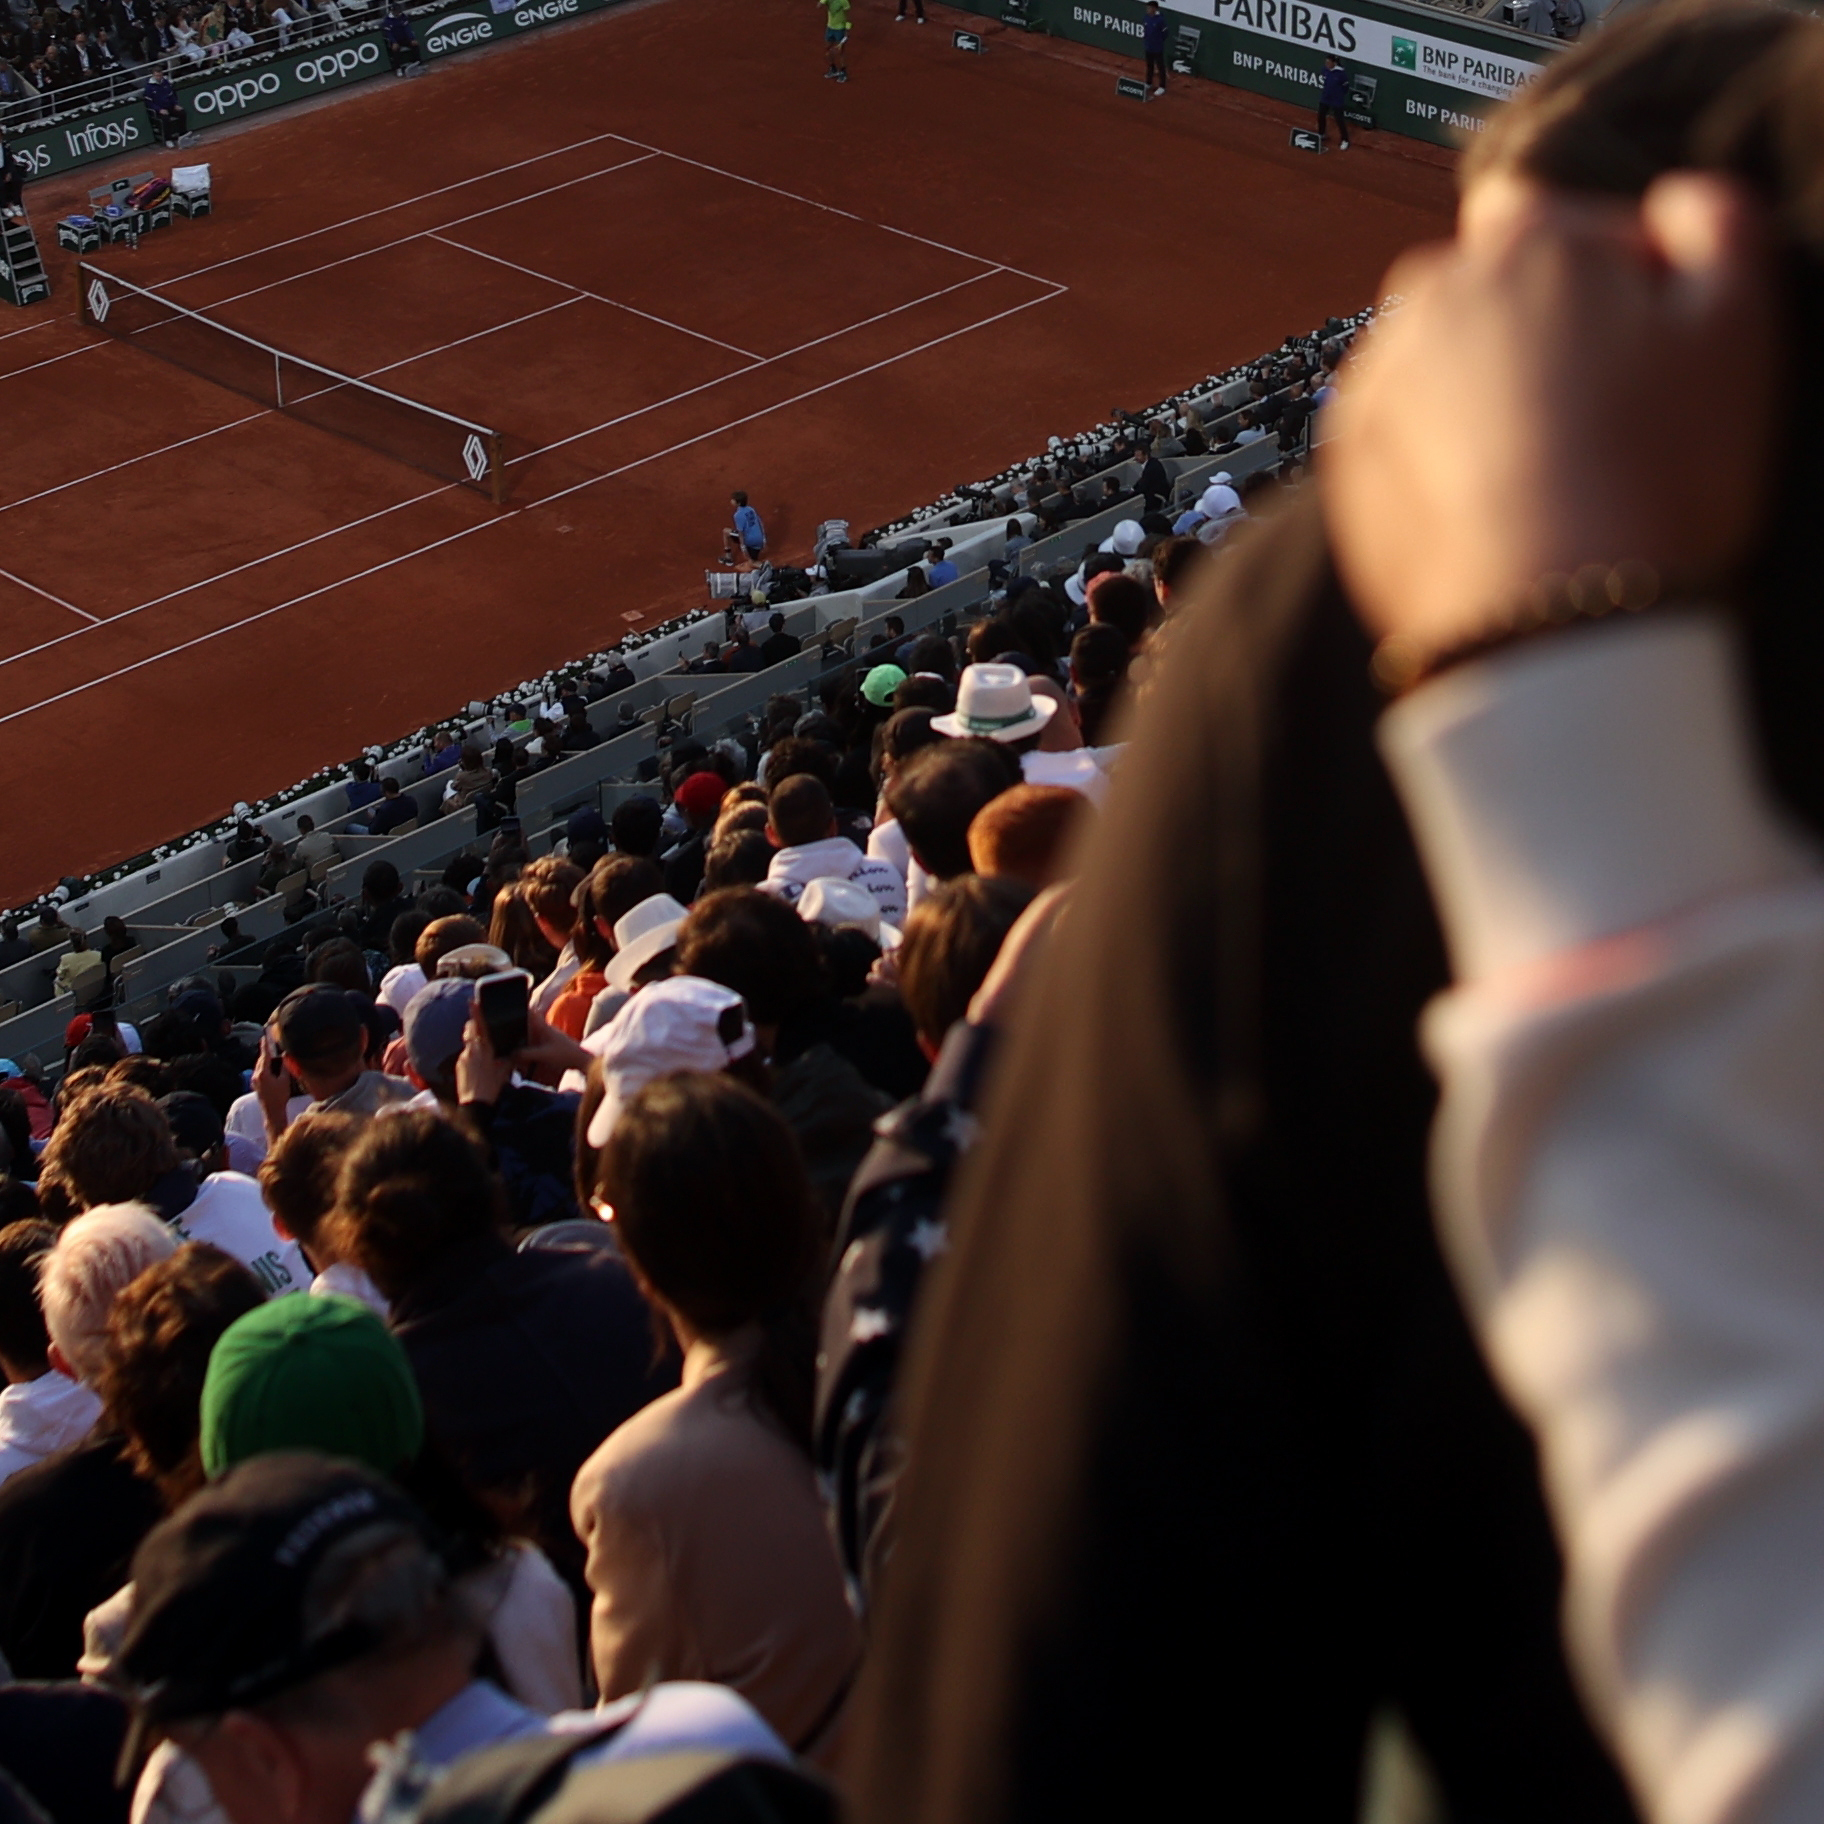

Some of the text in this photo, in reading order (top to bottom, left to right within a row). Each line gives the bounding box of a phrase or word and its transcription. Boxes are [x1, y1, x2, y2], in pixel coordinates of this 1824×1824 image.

[1074, 6, 1145, 39] BNP PARIB
[1233, 50, 1263, 71] BNP
[1423, 45, 1458, 69] BNP
[194, 42, 379, 116] oppo oppo
[1406, 98, 1485, 133] BNP PARIB
[66, 117, 139, 158] Infosys
